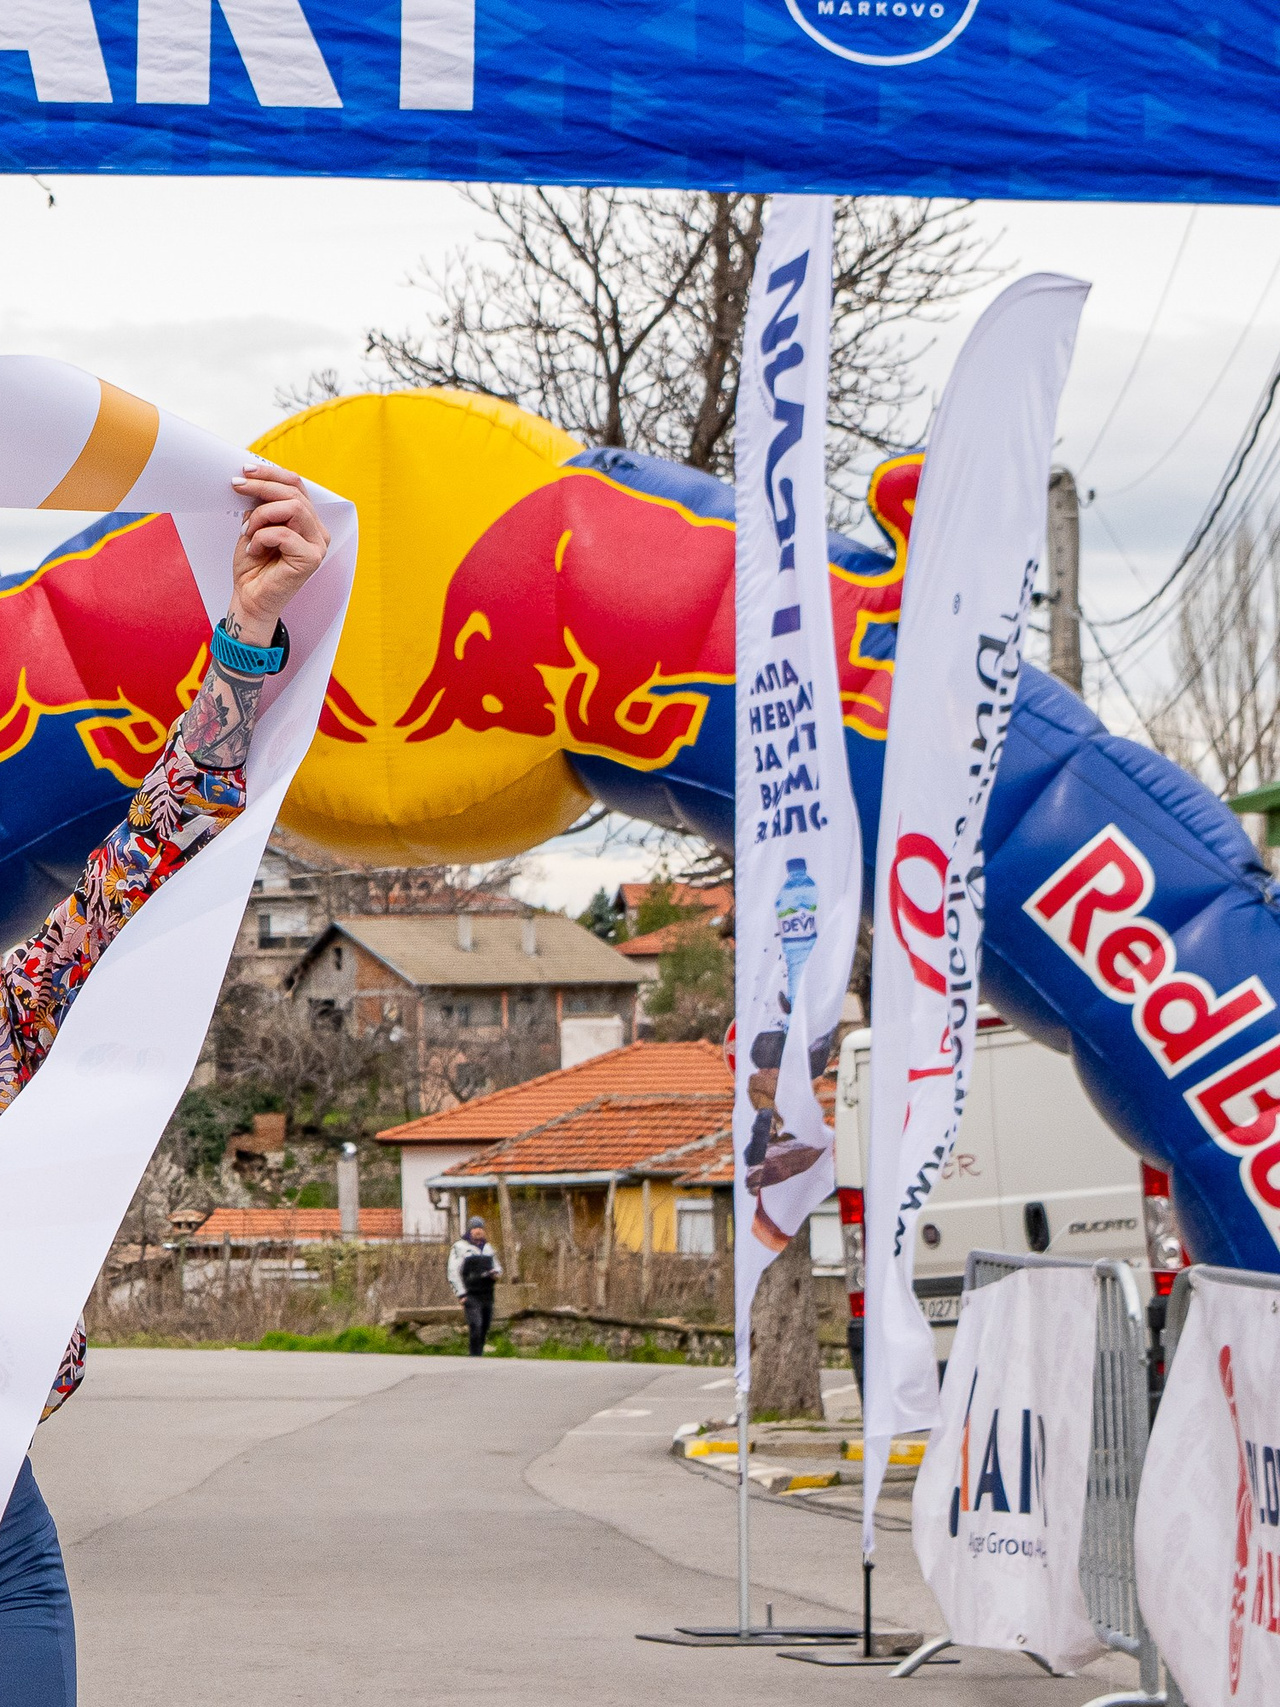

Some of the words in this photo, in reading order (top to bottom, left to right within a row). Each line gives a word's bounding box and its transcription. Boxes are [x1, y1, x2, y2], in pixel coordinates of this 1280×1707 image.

[818, 1, 944, 18] MARKOVO
[1034, 835, 1263, 1066] Red
[1069, 1218, 1137, 1235] DUCATO
